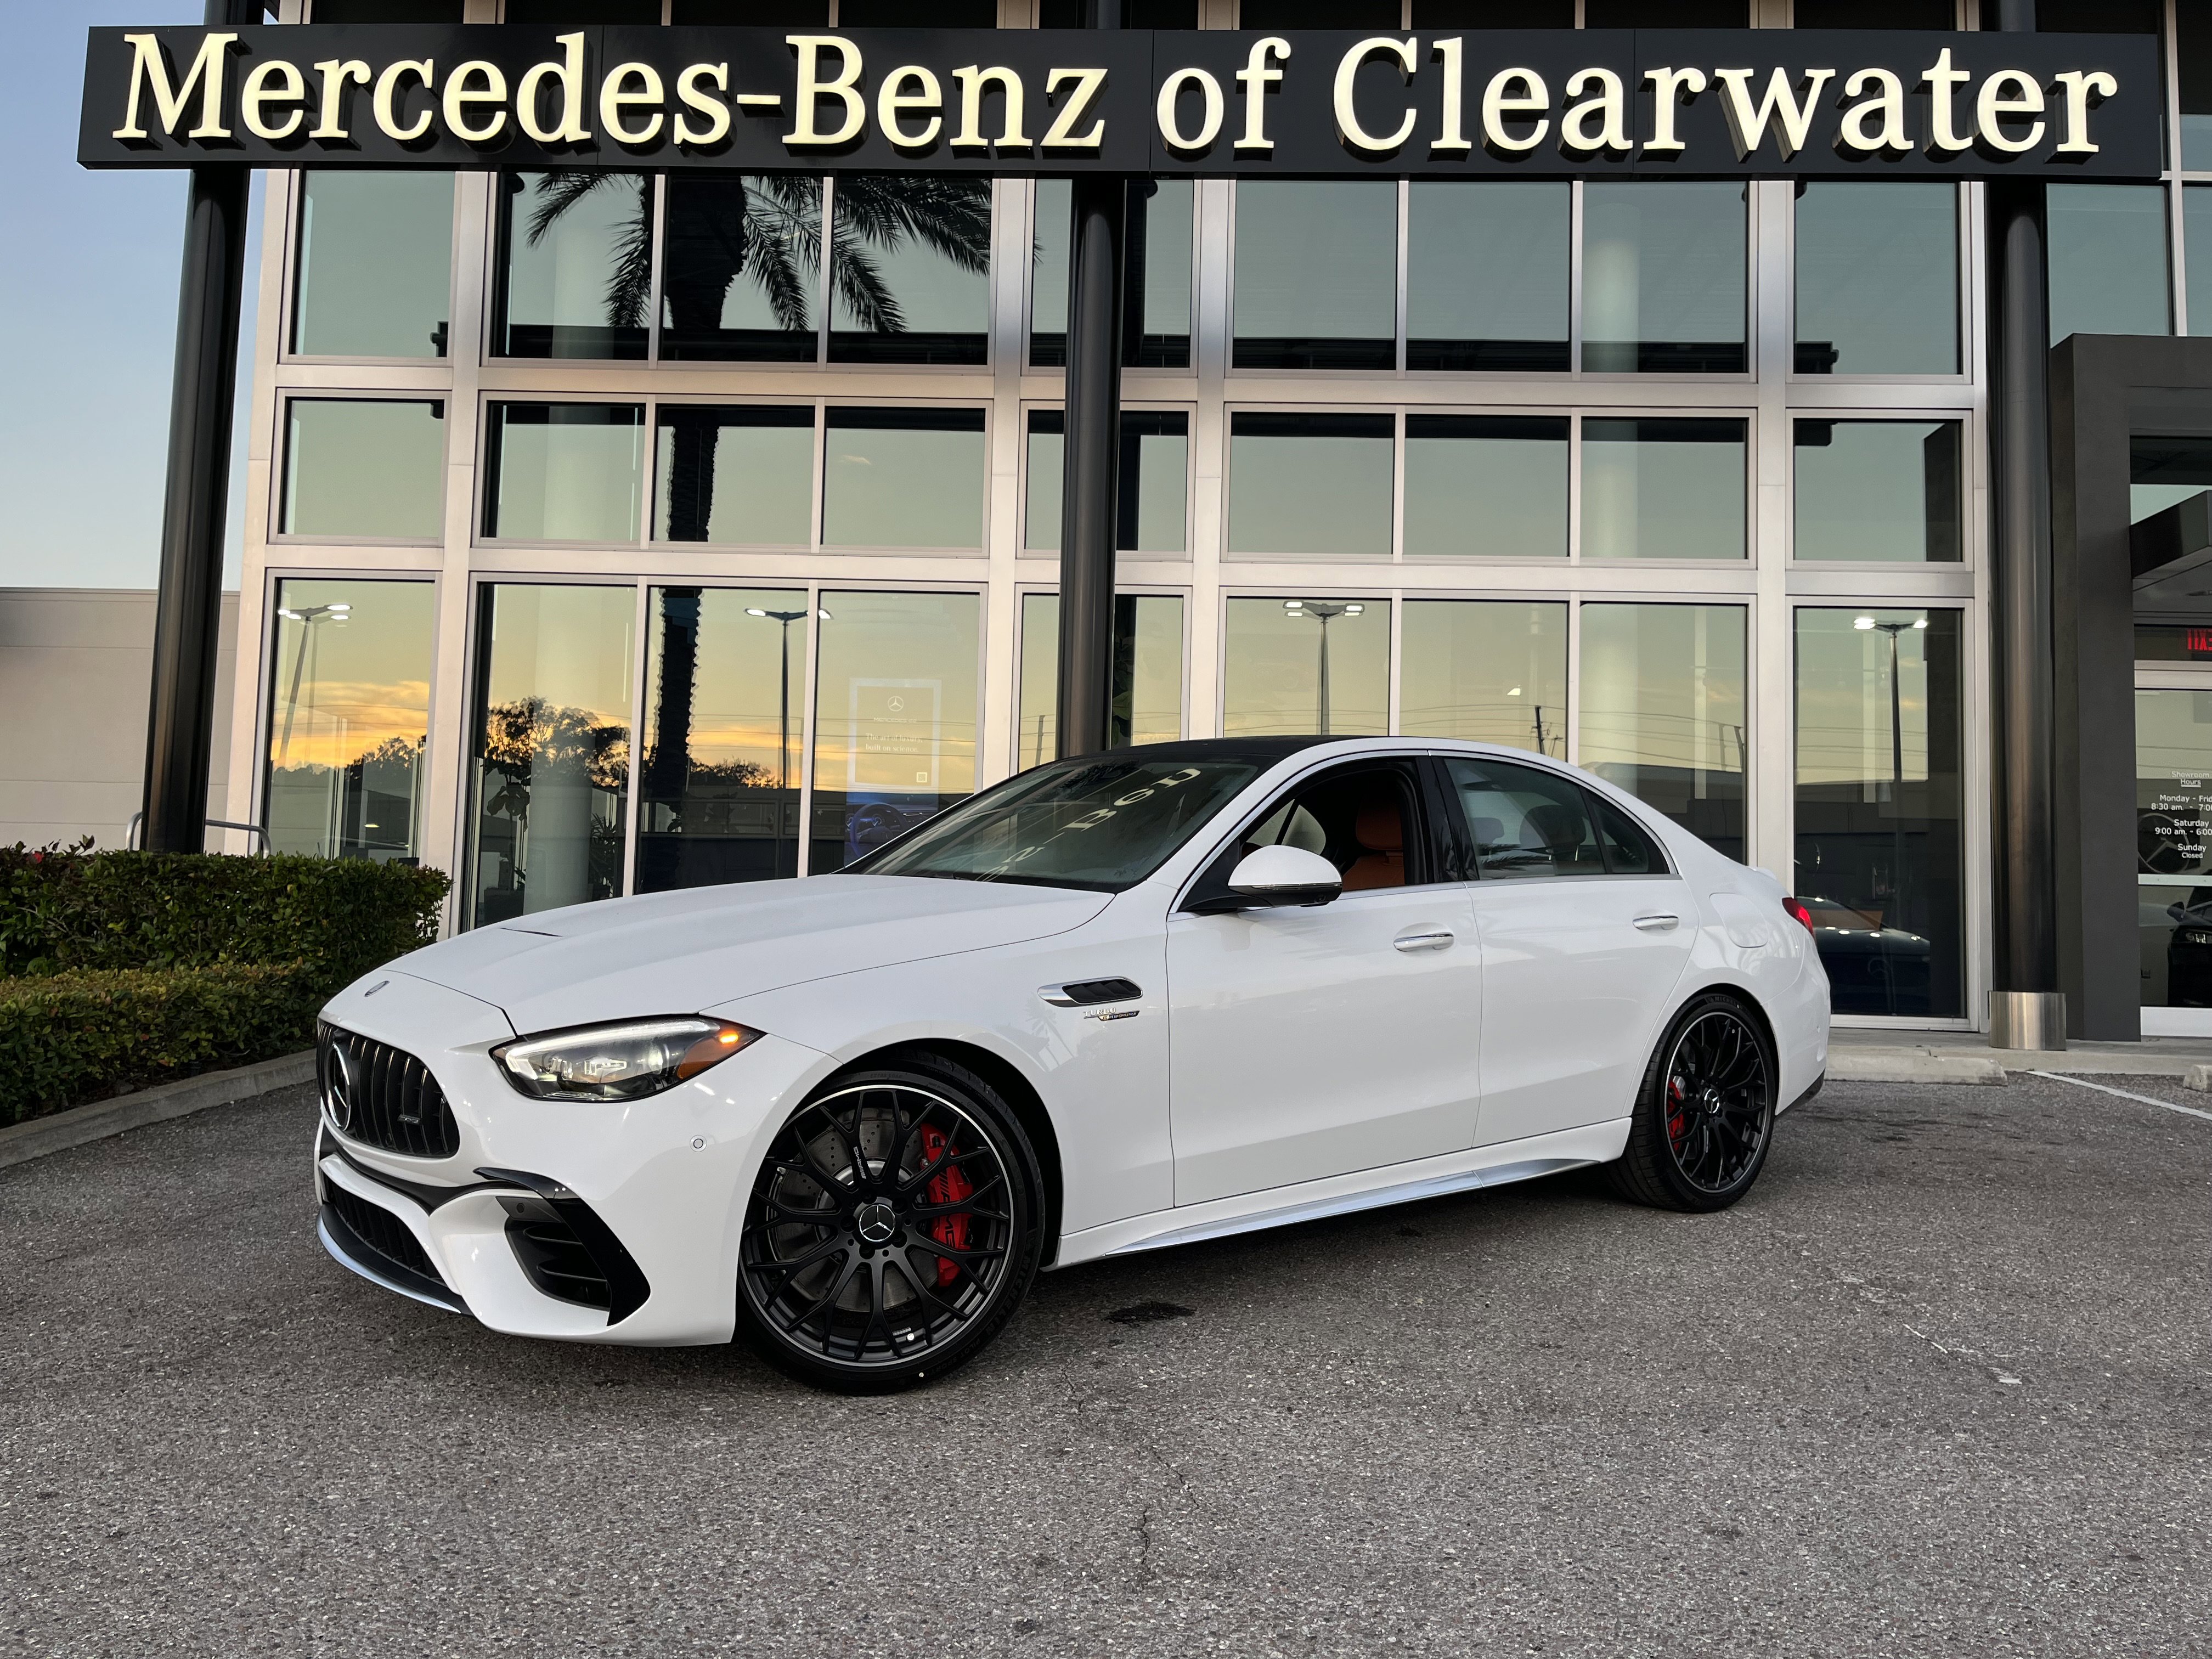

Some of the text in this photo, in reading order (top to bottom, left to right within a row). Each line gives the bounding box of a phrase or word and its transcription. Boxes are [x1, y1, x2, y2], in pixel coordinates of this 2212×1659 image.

[112, 31, 2118, 153] Mercedes-Benz of Clearwater
[2160, 794, 2190, 803] Monday
[2174, 819, 2209, 828] Saturday
[2177, 843, 2207, 853] Sunday
[1084, 1007, 1116, 1017] TURBO
